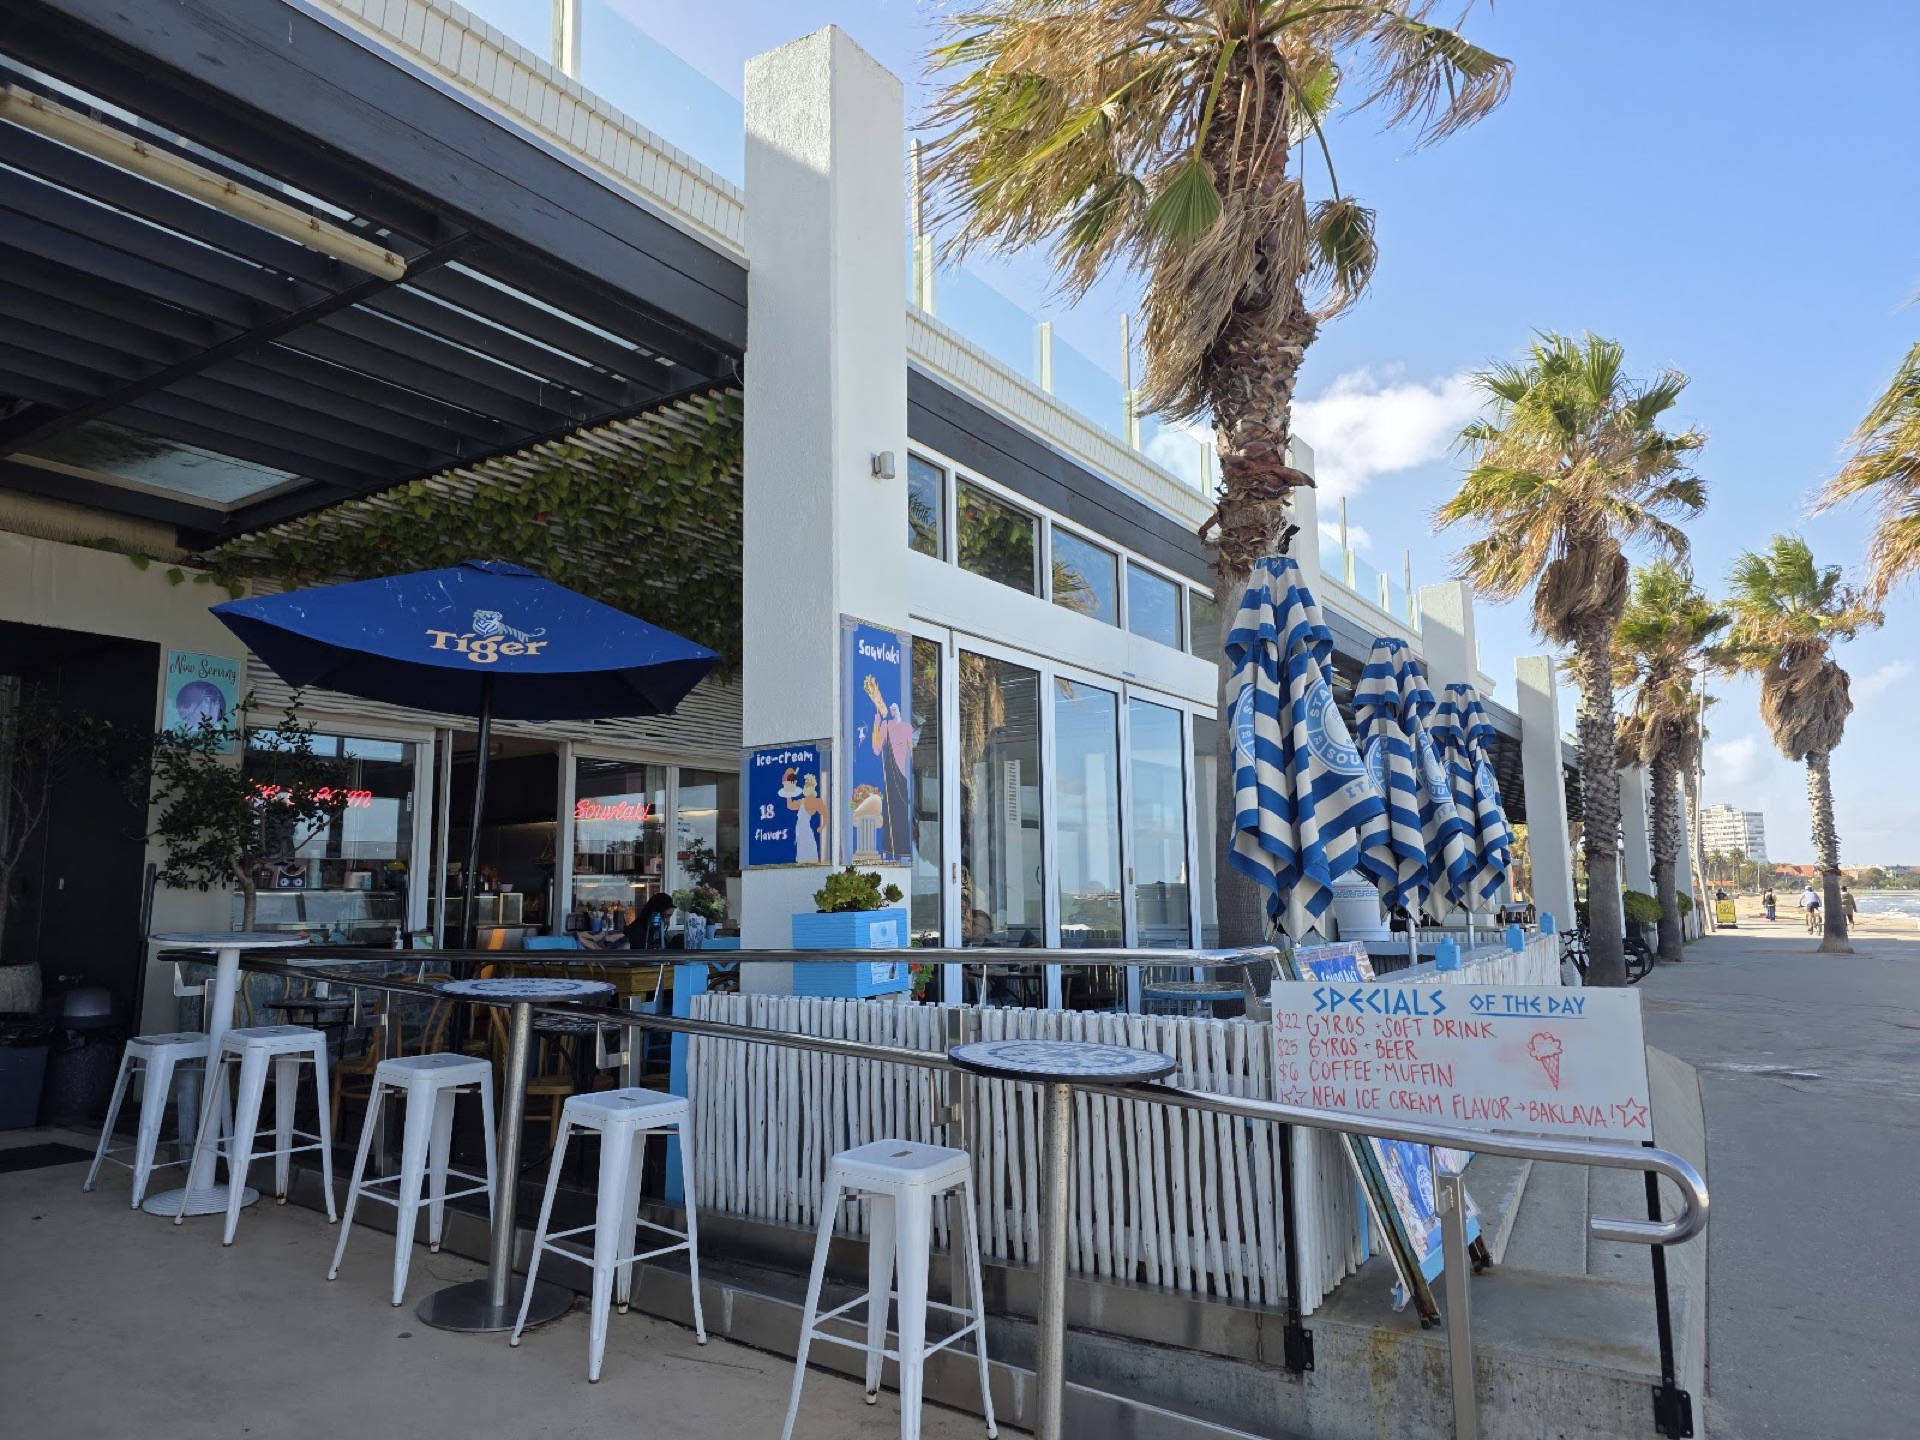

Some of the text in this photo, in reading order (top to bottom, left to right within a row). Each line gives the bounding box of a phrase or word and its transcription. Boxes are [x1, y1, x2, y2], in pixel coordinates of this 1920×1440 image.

[425, 629, 548, 663] Tiger
[169, 654, 237, 685] Now Serving
[756, 750, 813, 767] ice-cream
[759, 803, 776, 821] 18
[1312, 986, 1586, 1015] SPECIALS OF THE DAY
[1275, 1008, 1301, 1032] $22
[1306, 1013, 1365, 1038] GYROS
[1433, 1018, 1499, 1040] DRINK
[1277, 1037, 1299, 1057] $25
[1308, 1036, 1358, 1059] GYROS
[1375, 1038, 1418, 1061] BEER
[1309, 1059, 1373, 1083] COFFEE
[1384, 1062, 1453, 1088] MUFFIN
[1312, 1085, 1347, 1109] NEW
[1355, 1087, 1382, 1110] ICE
[1389, 1090, 1443, 1116] CREAM
[1452, 1093, 1513, 1121] FLAVOR
